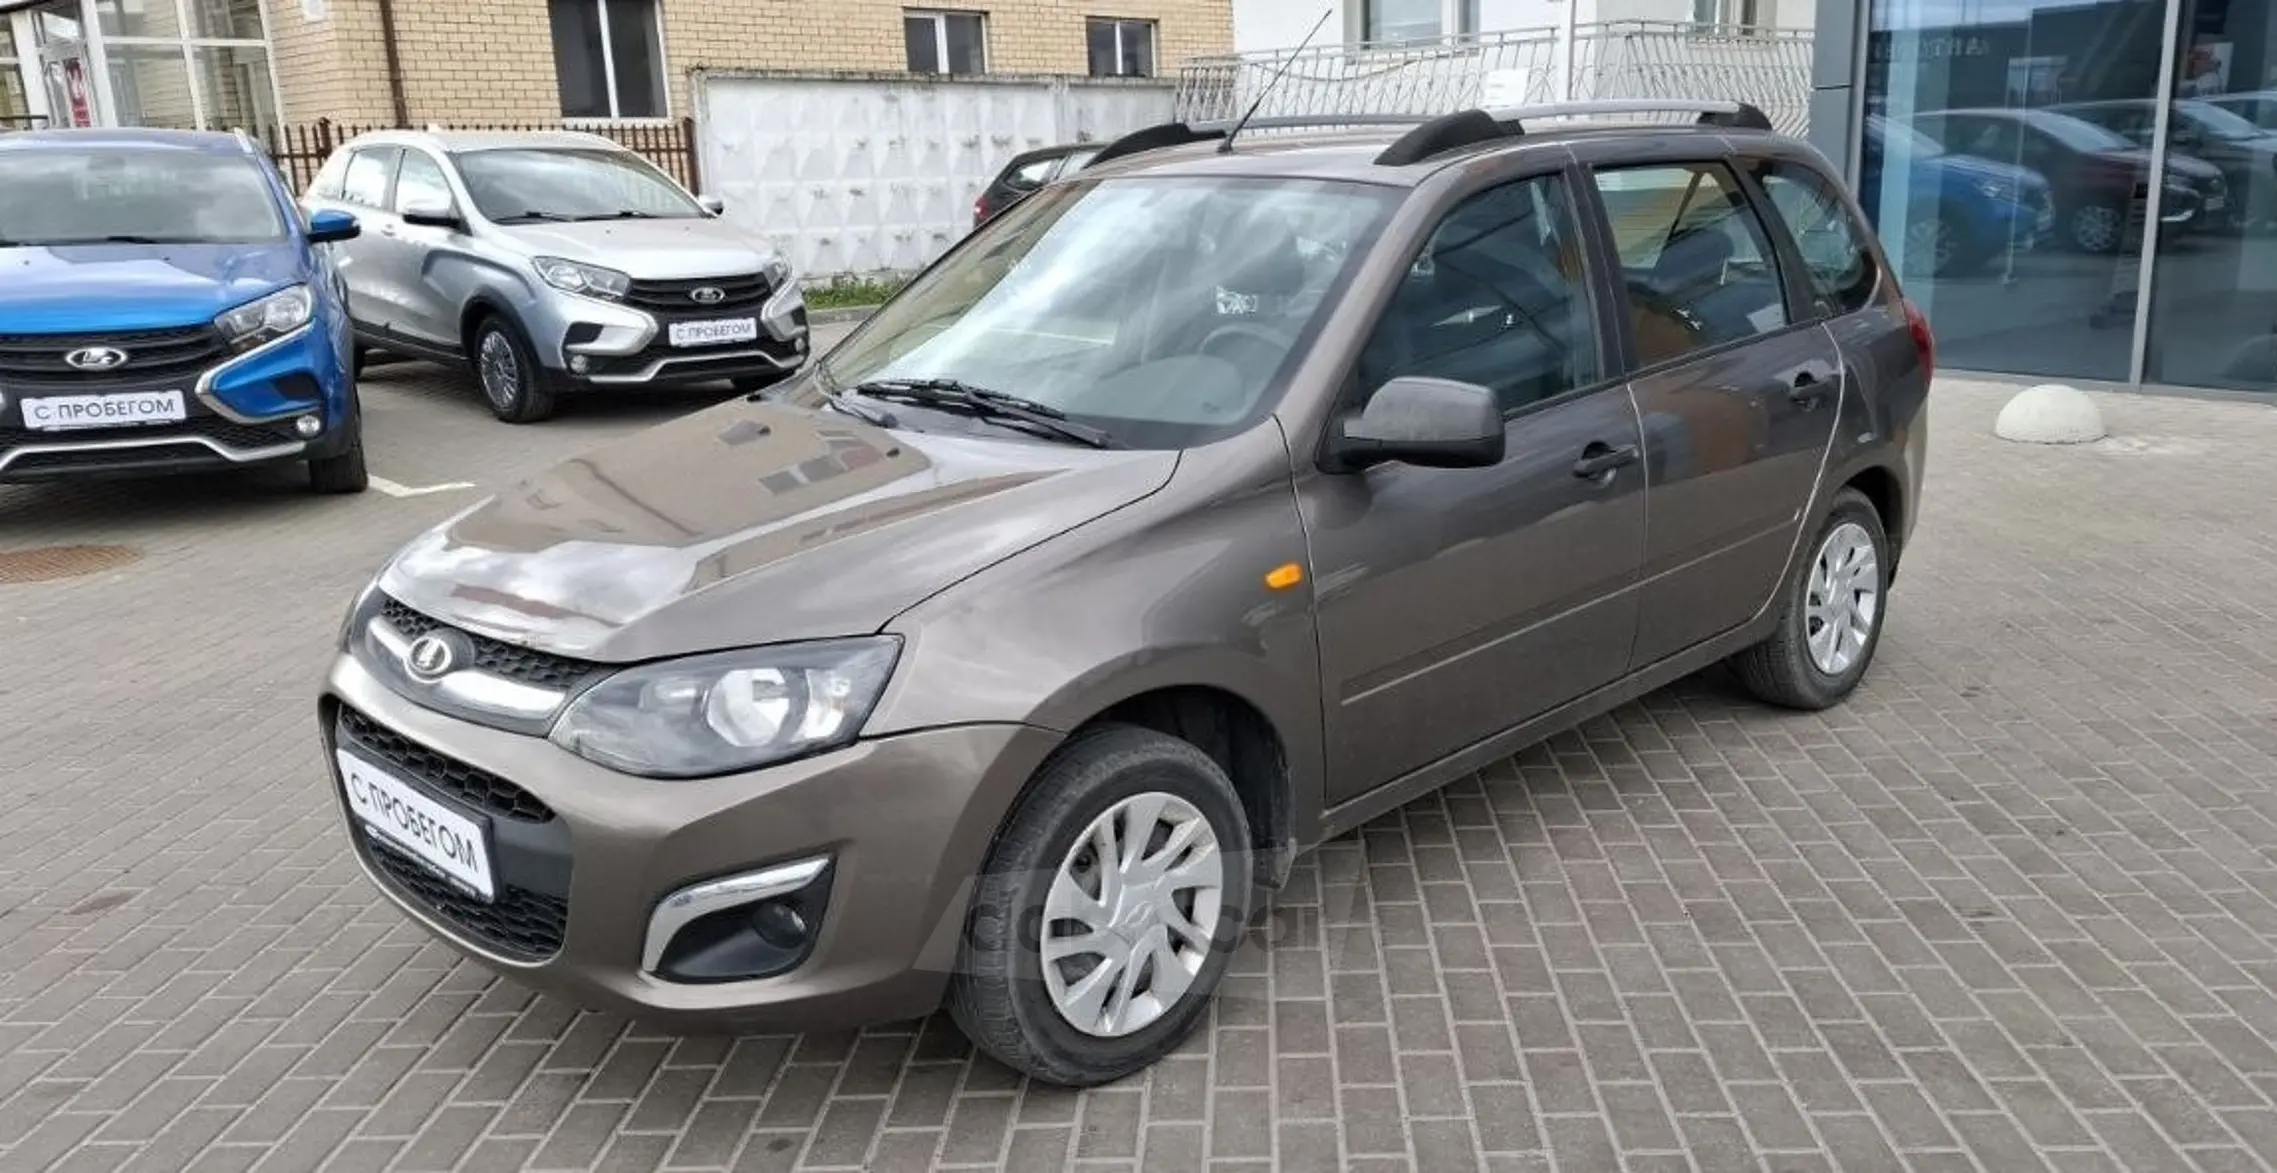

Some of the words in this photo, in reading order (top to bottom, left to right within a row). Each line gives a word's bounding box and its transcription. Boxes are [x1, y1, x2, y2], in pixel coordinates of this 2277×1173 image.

[34, 405, 50, 420] С
[57, 398, 175, 419] ПРОБЕГОМ
[351, 773, 367, 805] С
[368, 782, 479, 873] ПРОБЕГОМ
